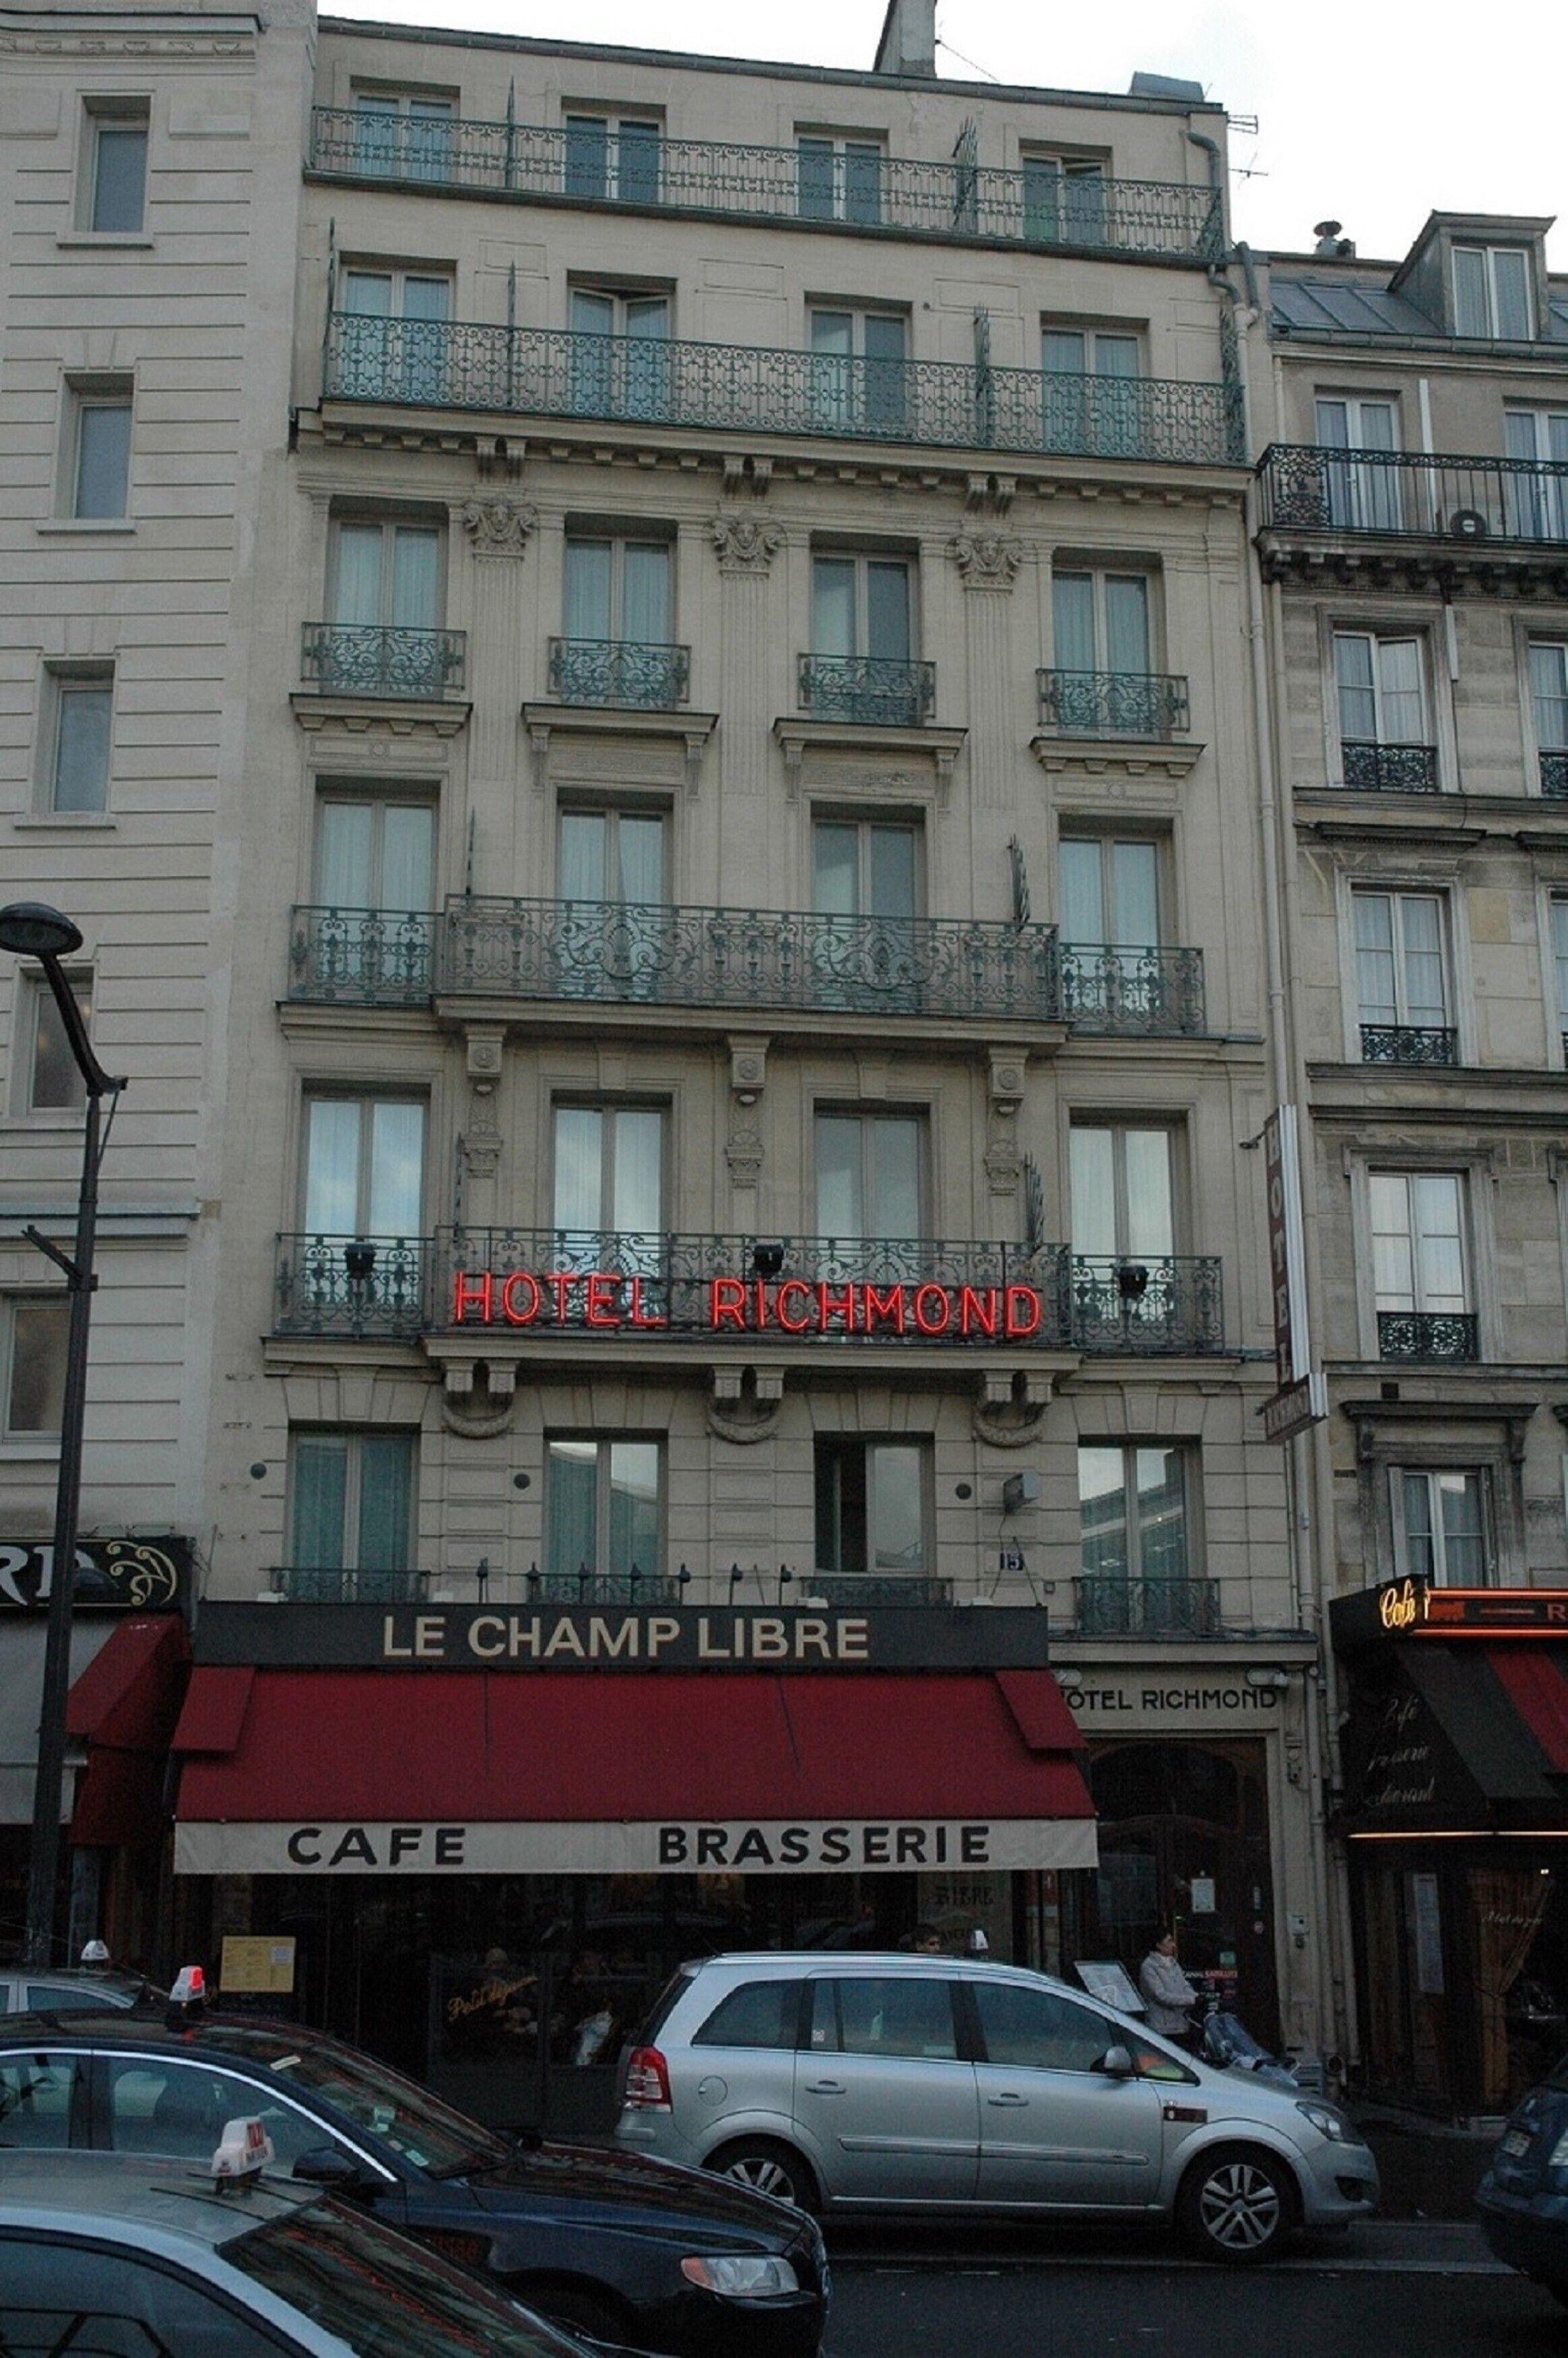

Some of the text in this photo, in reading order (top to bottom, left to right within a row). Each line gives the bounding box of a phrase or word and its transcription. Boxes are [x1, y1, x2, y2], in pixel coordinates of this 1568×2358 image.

[1268, 1118, 1293, 1385] HOTEL
[455, 1273, 1040, 1335] HOTEL RICHMOND
[1003, 1551, 1020, 1570] 15
[382, 1615, 870, 1659] LE CHAMP LIBRE
[1141, 1688, 1277, 1711] RICHMOND
[287, 1824, 990, 1867] CAFE BRASSERIE
